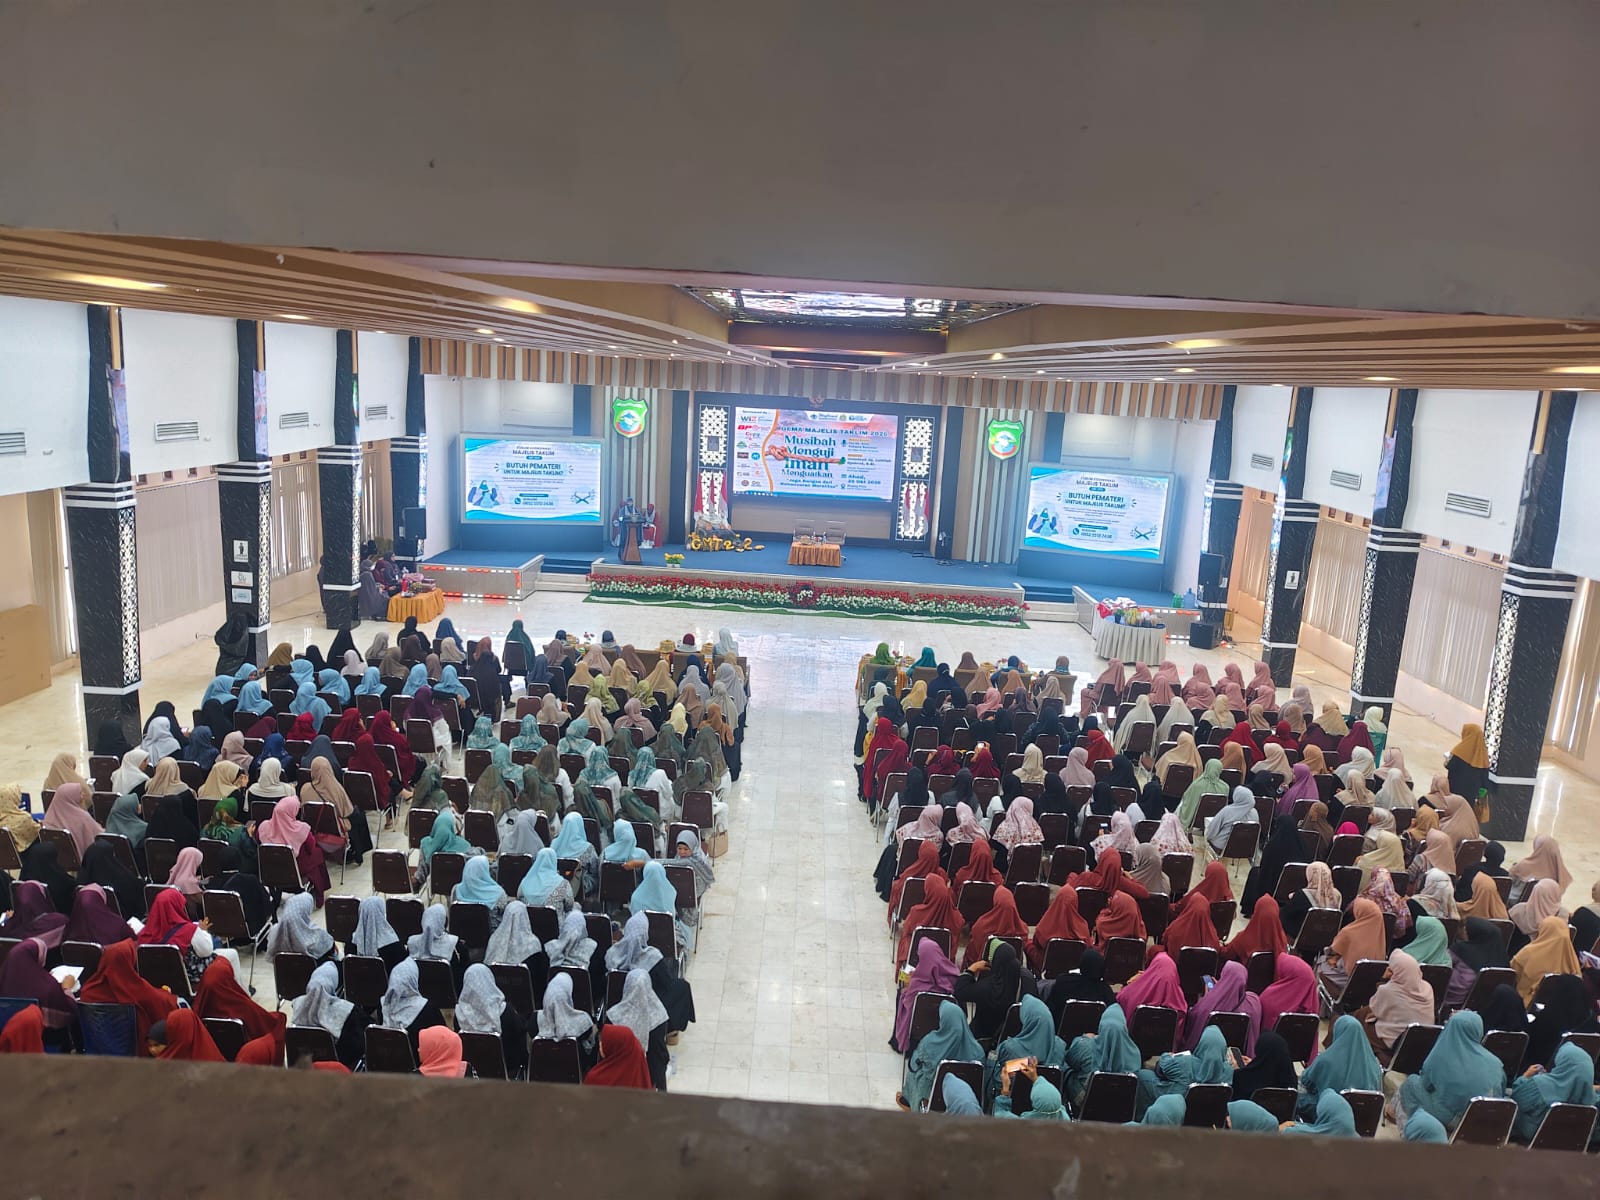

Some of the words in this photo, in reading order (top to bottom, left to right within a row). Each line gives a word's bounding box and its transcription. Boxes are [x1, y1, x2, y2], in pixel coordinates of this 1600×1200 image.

[784, 435, 836, 446] Musibah
[786, 446, 835, 458] Menguji
[784, 457, 829, 470] Iman
[781, 469, 833, 478] Menguatkan
[1068, 492, 1091, 500] BUTUH
[1091, 494, 1124, 503] PEMATERI
